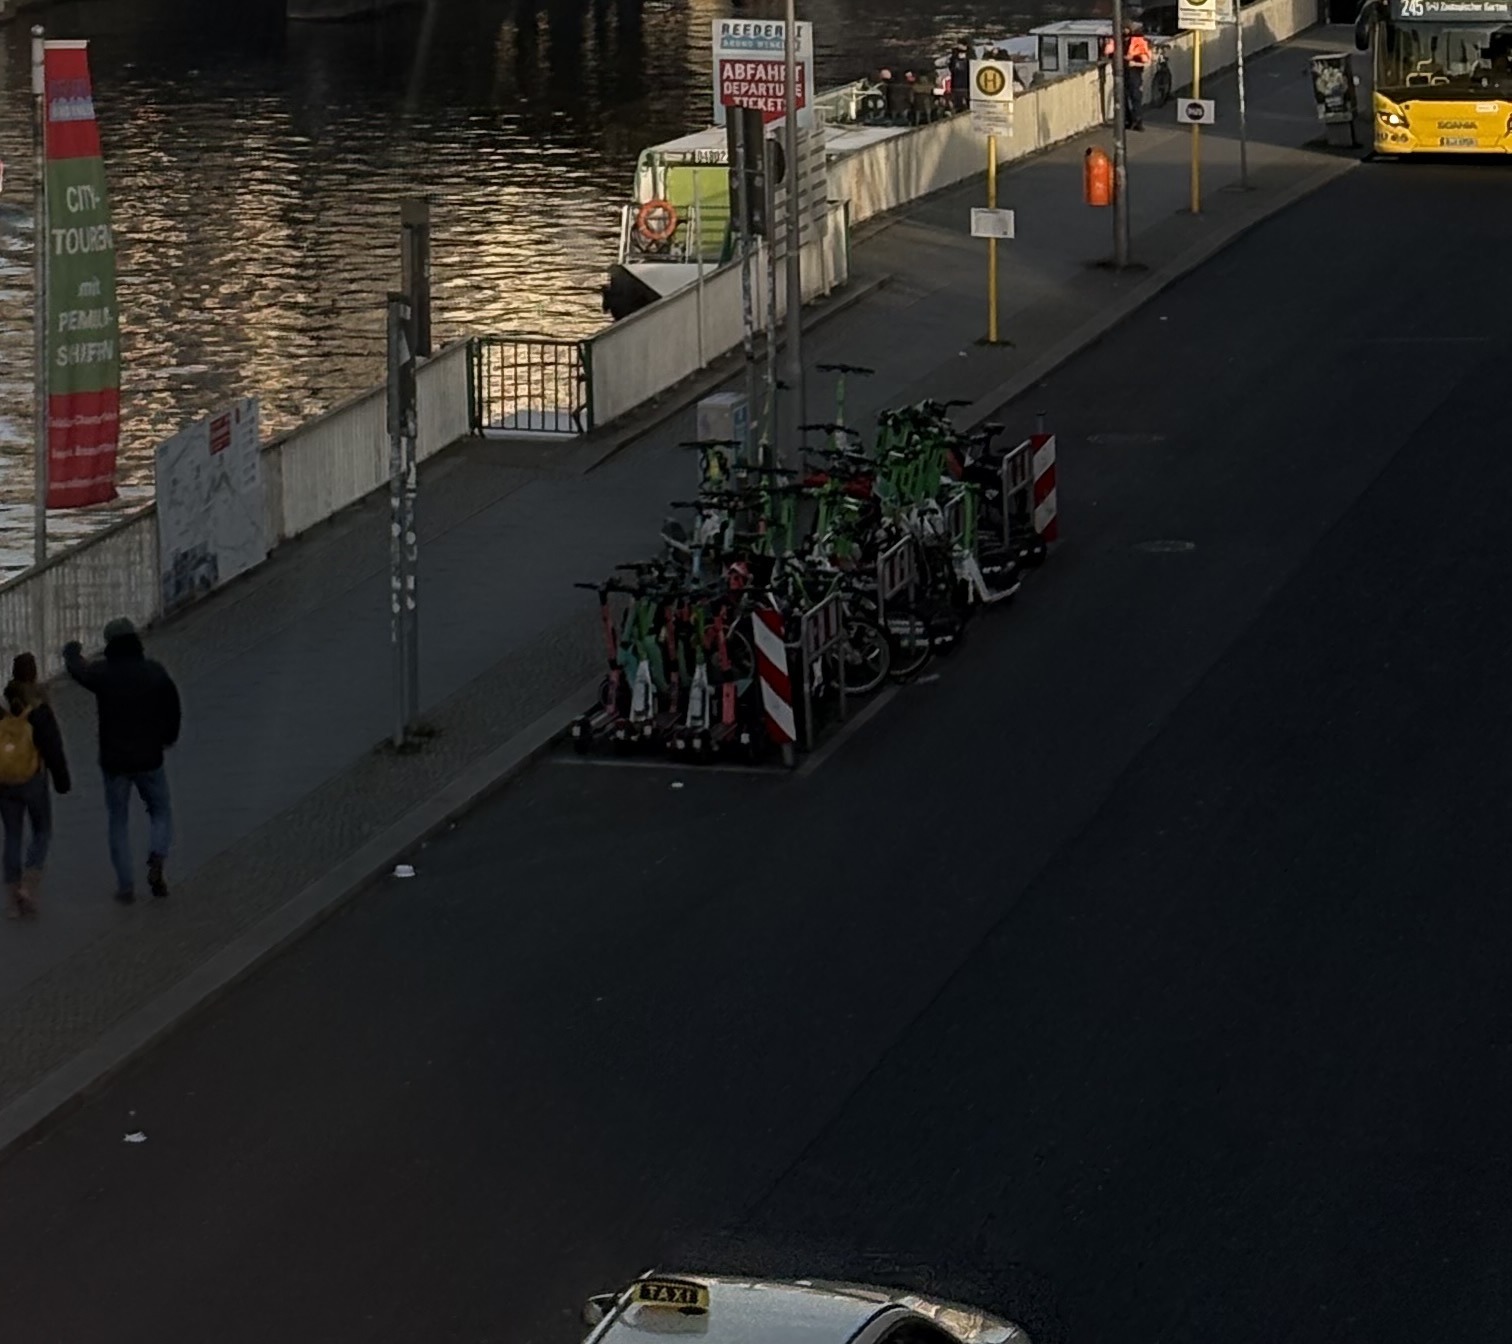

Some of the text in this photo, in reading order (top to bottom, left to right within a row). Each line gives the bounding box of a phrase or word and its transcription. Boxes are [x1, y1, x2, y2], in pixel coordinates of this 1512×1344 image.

[721, 23, 803, 38] REEDERI
[723, 81, 802, 97] DEPARTUE
[732, 96, 787, 112] TICKET
[646, 1285, 691, 1302] TAXI
